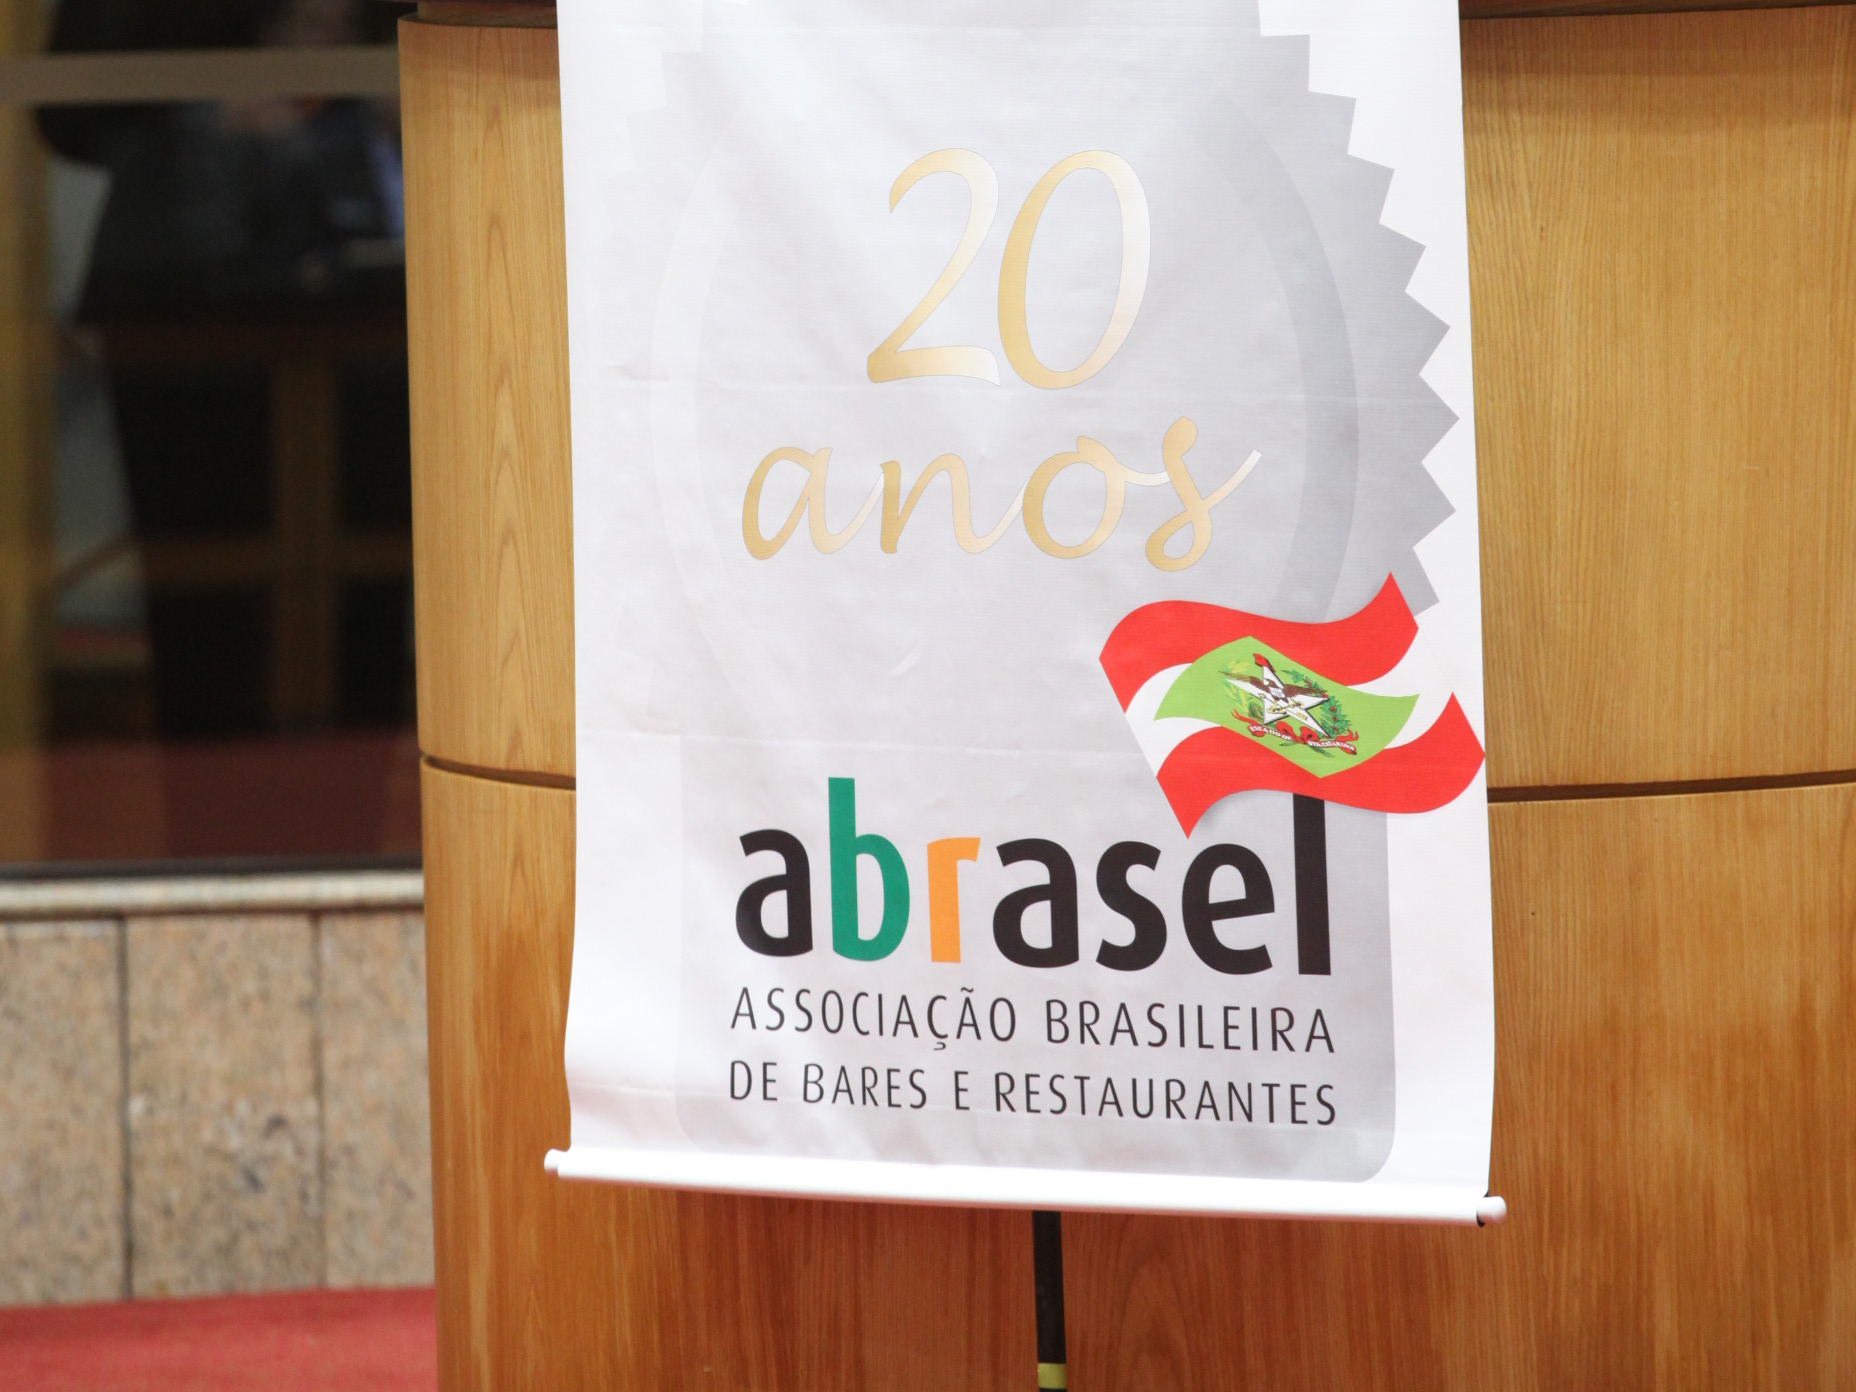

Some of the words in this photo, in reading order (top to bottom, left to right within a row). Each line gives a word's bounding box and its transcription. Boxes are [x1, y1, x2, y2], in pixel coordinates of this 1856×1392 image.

[867, 148, 1151, 390] 20
[742, 416, 1262, 572] anos
[735, 777, 1331, 975] abrasel
[729, 1060, 778, 1101] DE
[803, 1063, 927, 1110] BARES
[955, 1071, 970, 1110] E
[994, 1072, 1337, 1126] RESTAURANTES
[731, 987, 1017, 1050] ASSOCIAÇÃO
[1046, 999, 1335, 1053] BRASILEIRA
